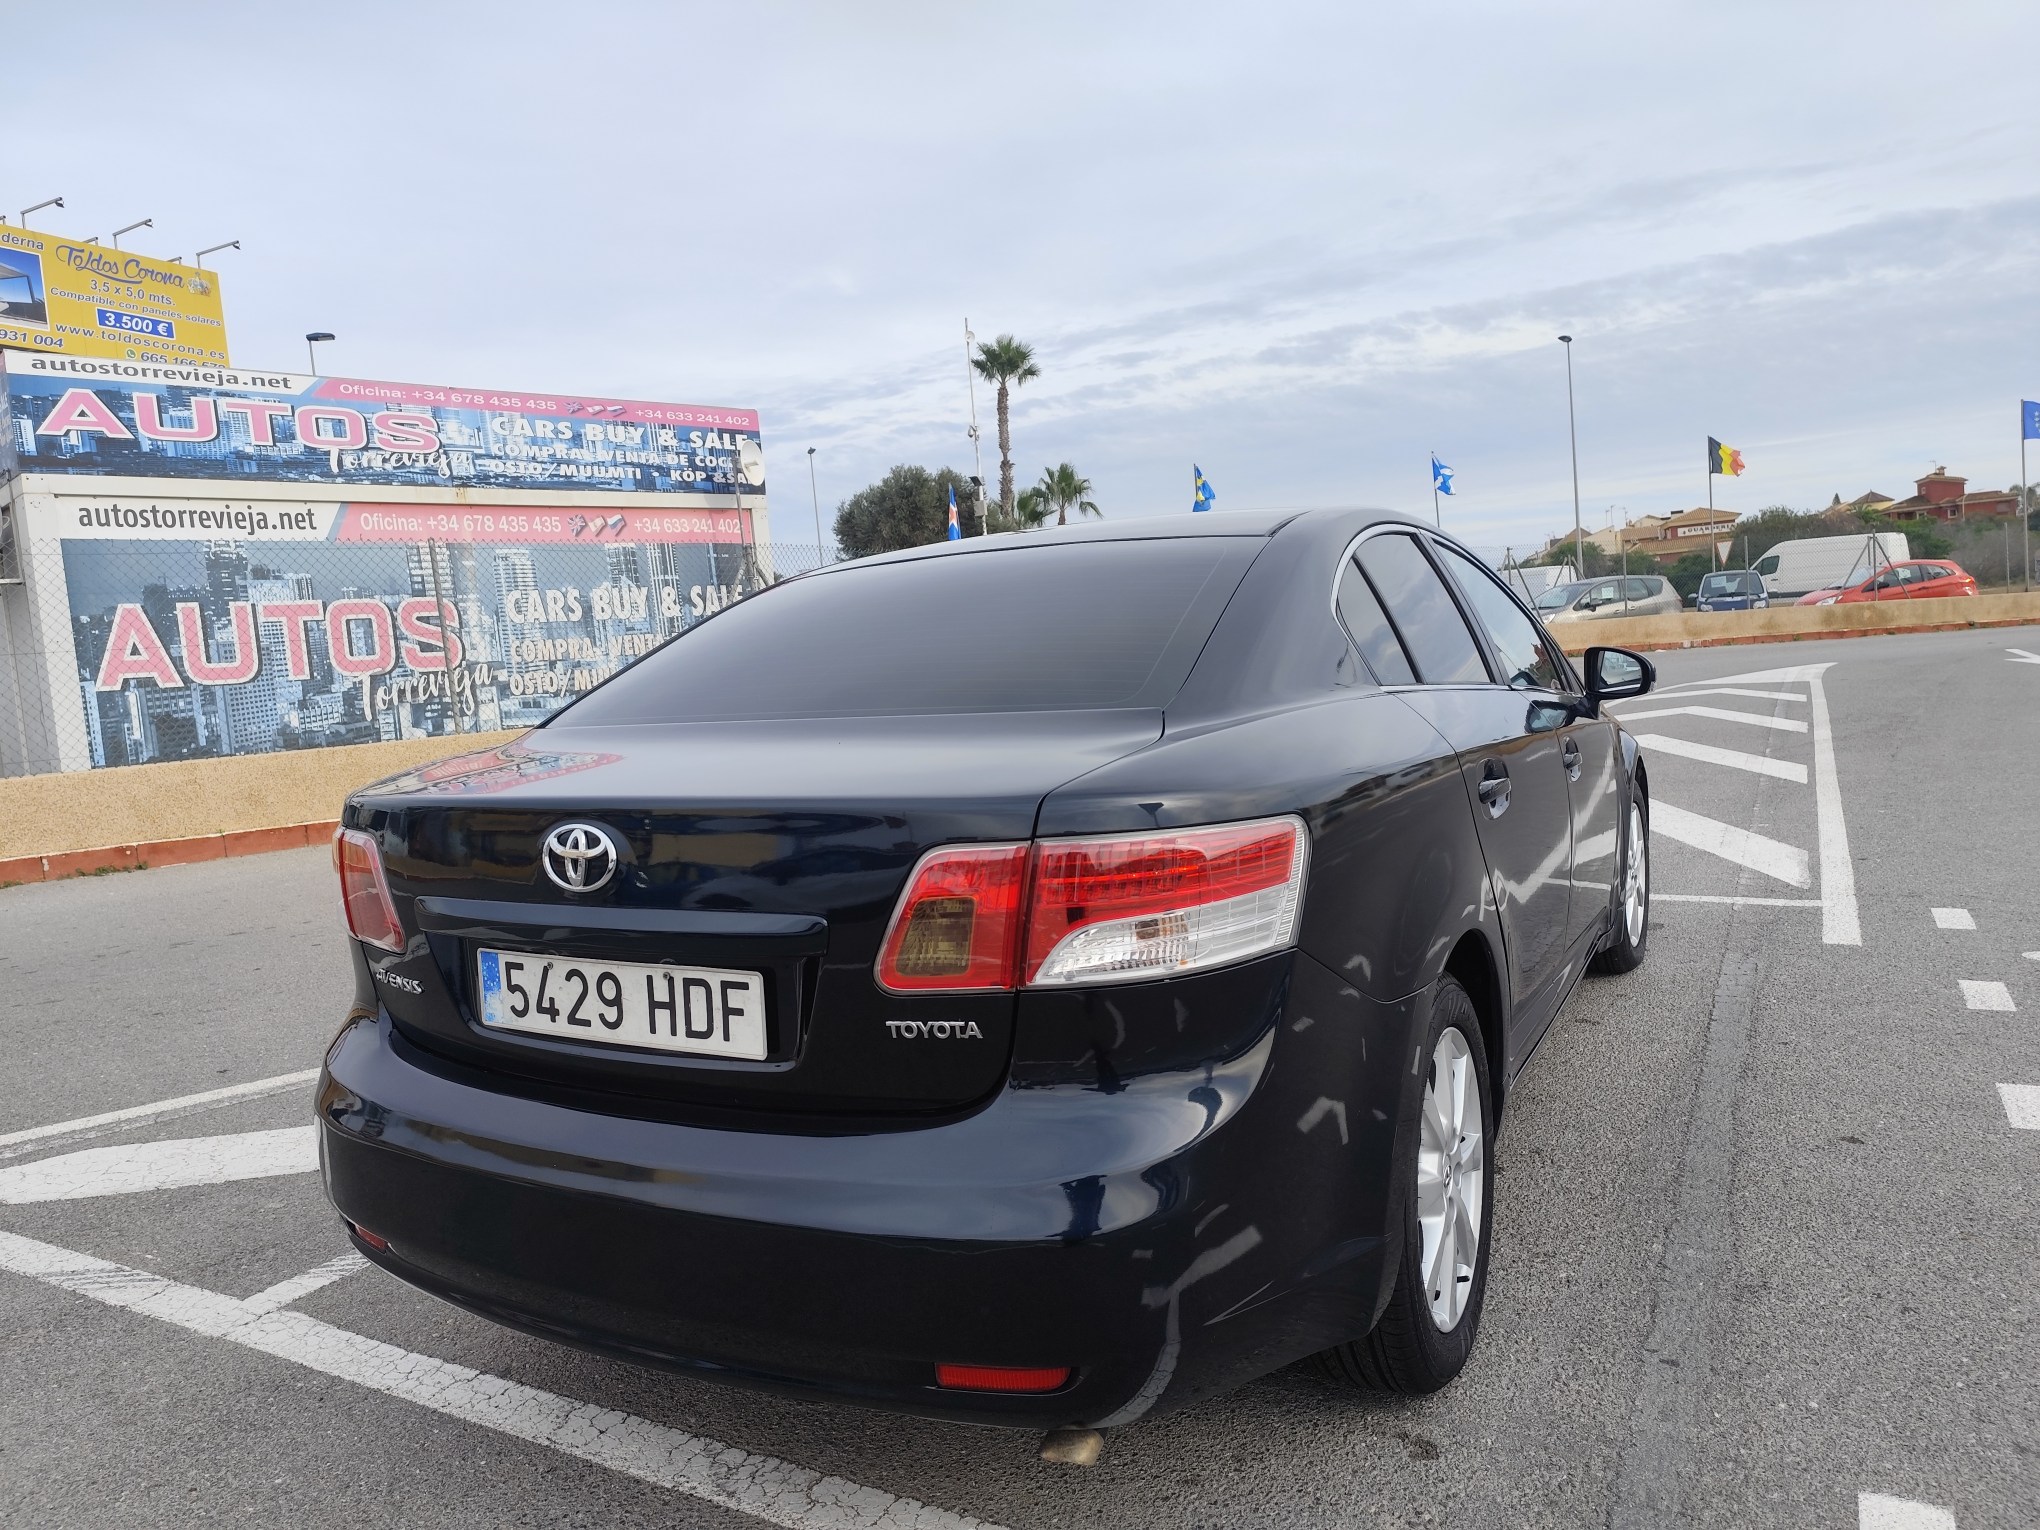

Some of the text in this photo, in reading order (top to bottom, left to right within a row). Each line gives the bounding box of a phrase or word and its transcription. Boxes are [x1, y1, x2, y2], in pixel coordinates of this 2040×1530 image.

[55, 245, 184, 288] Toldos Corona
[50, 287, 221, 327] Compatible con paneles solares
[90, 279, 110, 293] 3,5
[126, 286, 145, 300] 5,0
[149, 293, 176, 306] mts.
[104, 312, 169, 336] 3.500 €
[33, 334, 64, 348] 004
[55, 323, 225, 359] www.toldoscorona.es
[140, 352, 168, 364] 665
[31, 358, 293, 390] autostorrevieja.net
[339, 384, 557, 410] Oficina: +34 678 435 435
[35, 387, 442, 454] AUTOS
[491, 416, 574, 440] CARS
[585, 423, 645, 444] BUY
[658, 428, 679, 447] &
[635, 409, 750, 426] +34 633 241 402
[328, 447, 474, 480] Torrevieja
[667, 453, 689, 466] DE
[670, 467, 707, 482] KÖP
[78, 504, 318, 536] autostorrevieja.net
[360, 512, 562, 532] Oficina: +34 678 435 435
[634, 517, 741, 533] +34 633 241 402
[506, 588, 583, 623] CARS
[592, 585, 648, 620] BUY
[661, 585, 682, 618] &
[95, 597, 464, 692] AUTOS
[353, 661, 494, 722] Torrevieja
[376, 968, 423, 995] AVENSIS
[504, 961, 750, 1043] 5429 HDF
[885, 1020, 984, 1039] TOYOTA
